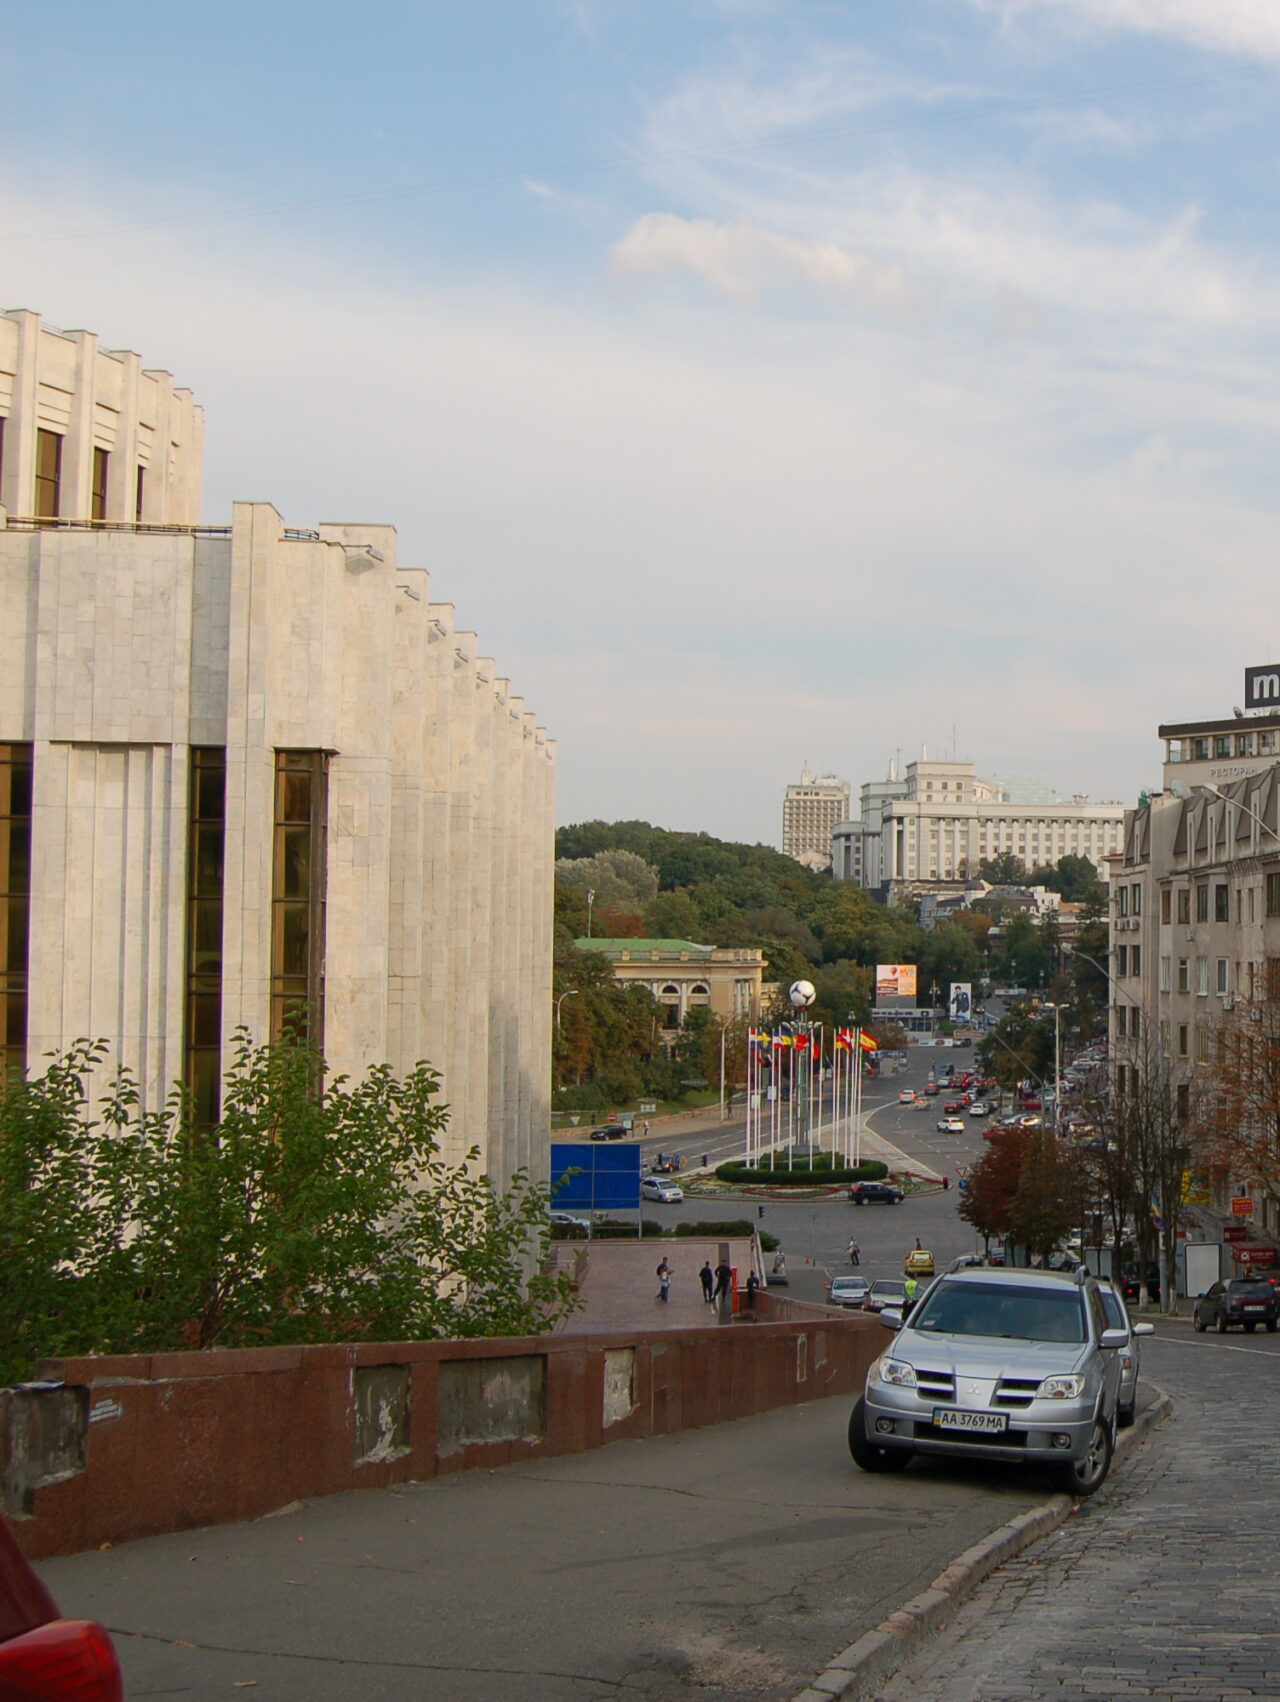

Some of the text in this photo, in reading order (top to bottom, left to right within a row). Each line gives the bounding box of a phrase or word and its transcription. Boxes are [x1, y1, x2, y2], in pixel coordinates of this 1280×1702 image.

[1209, 765, 1258, 777] РЕСТОРАН
[942, 1412, 1003, 1429] AA 3769 MA
